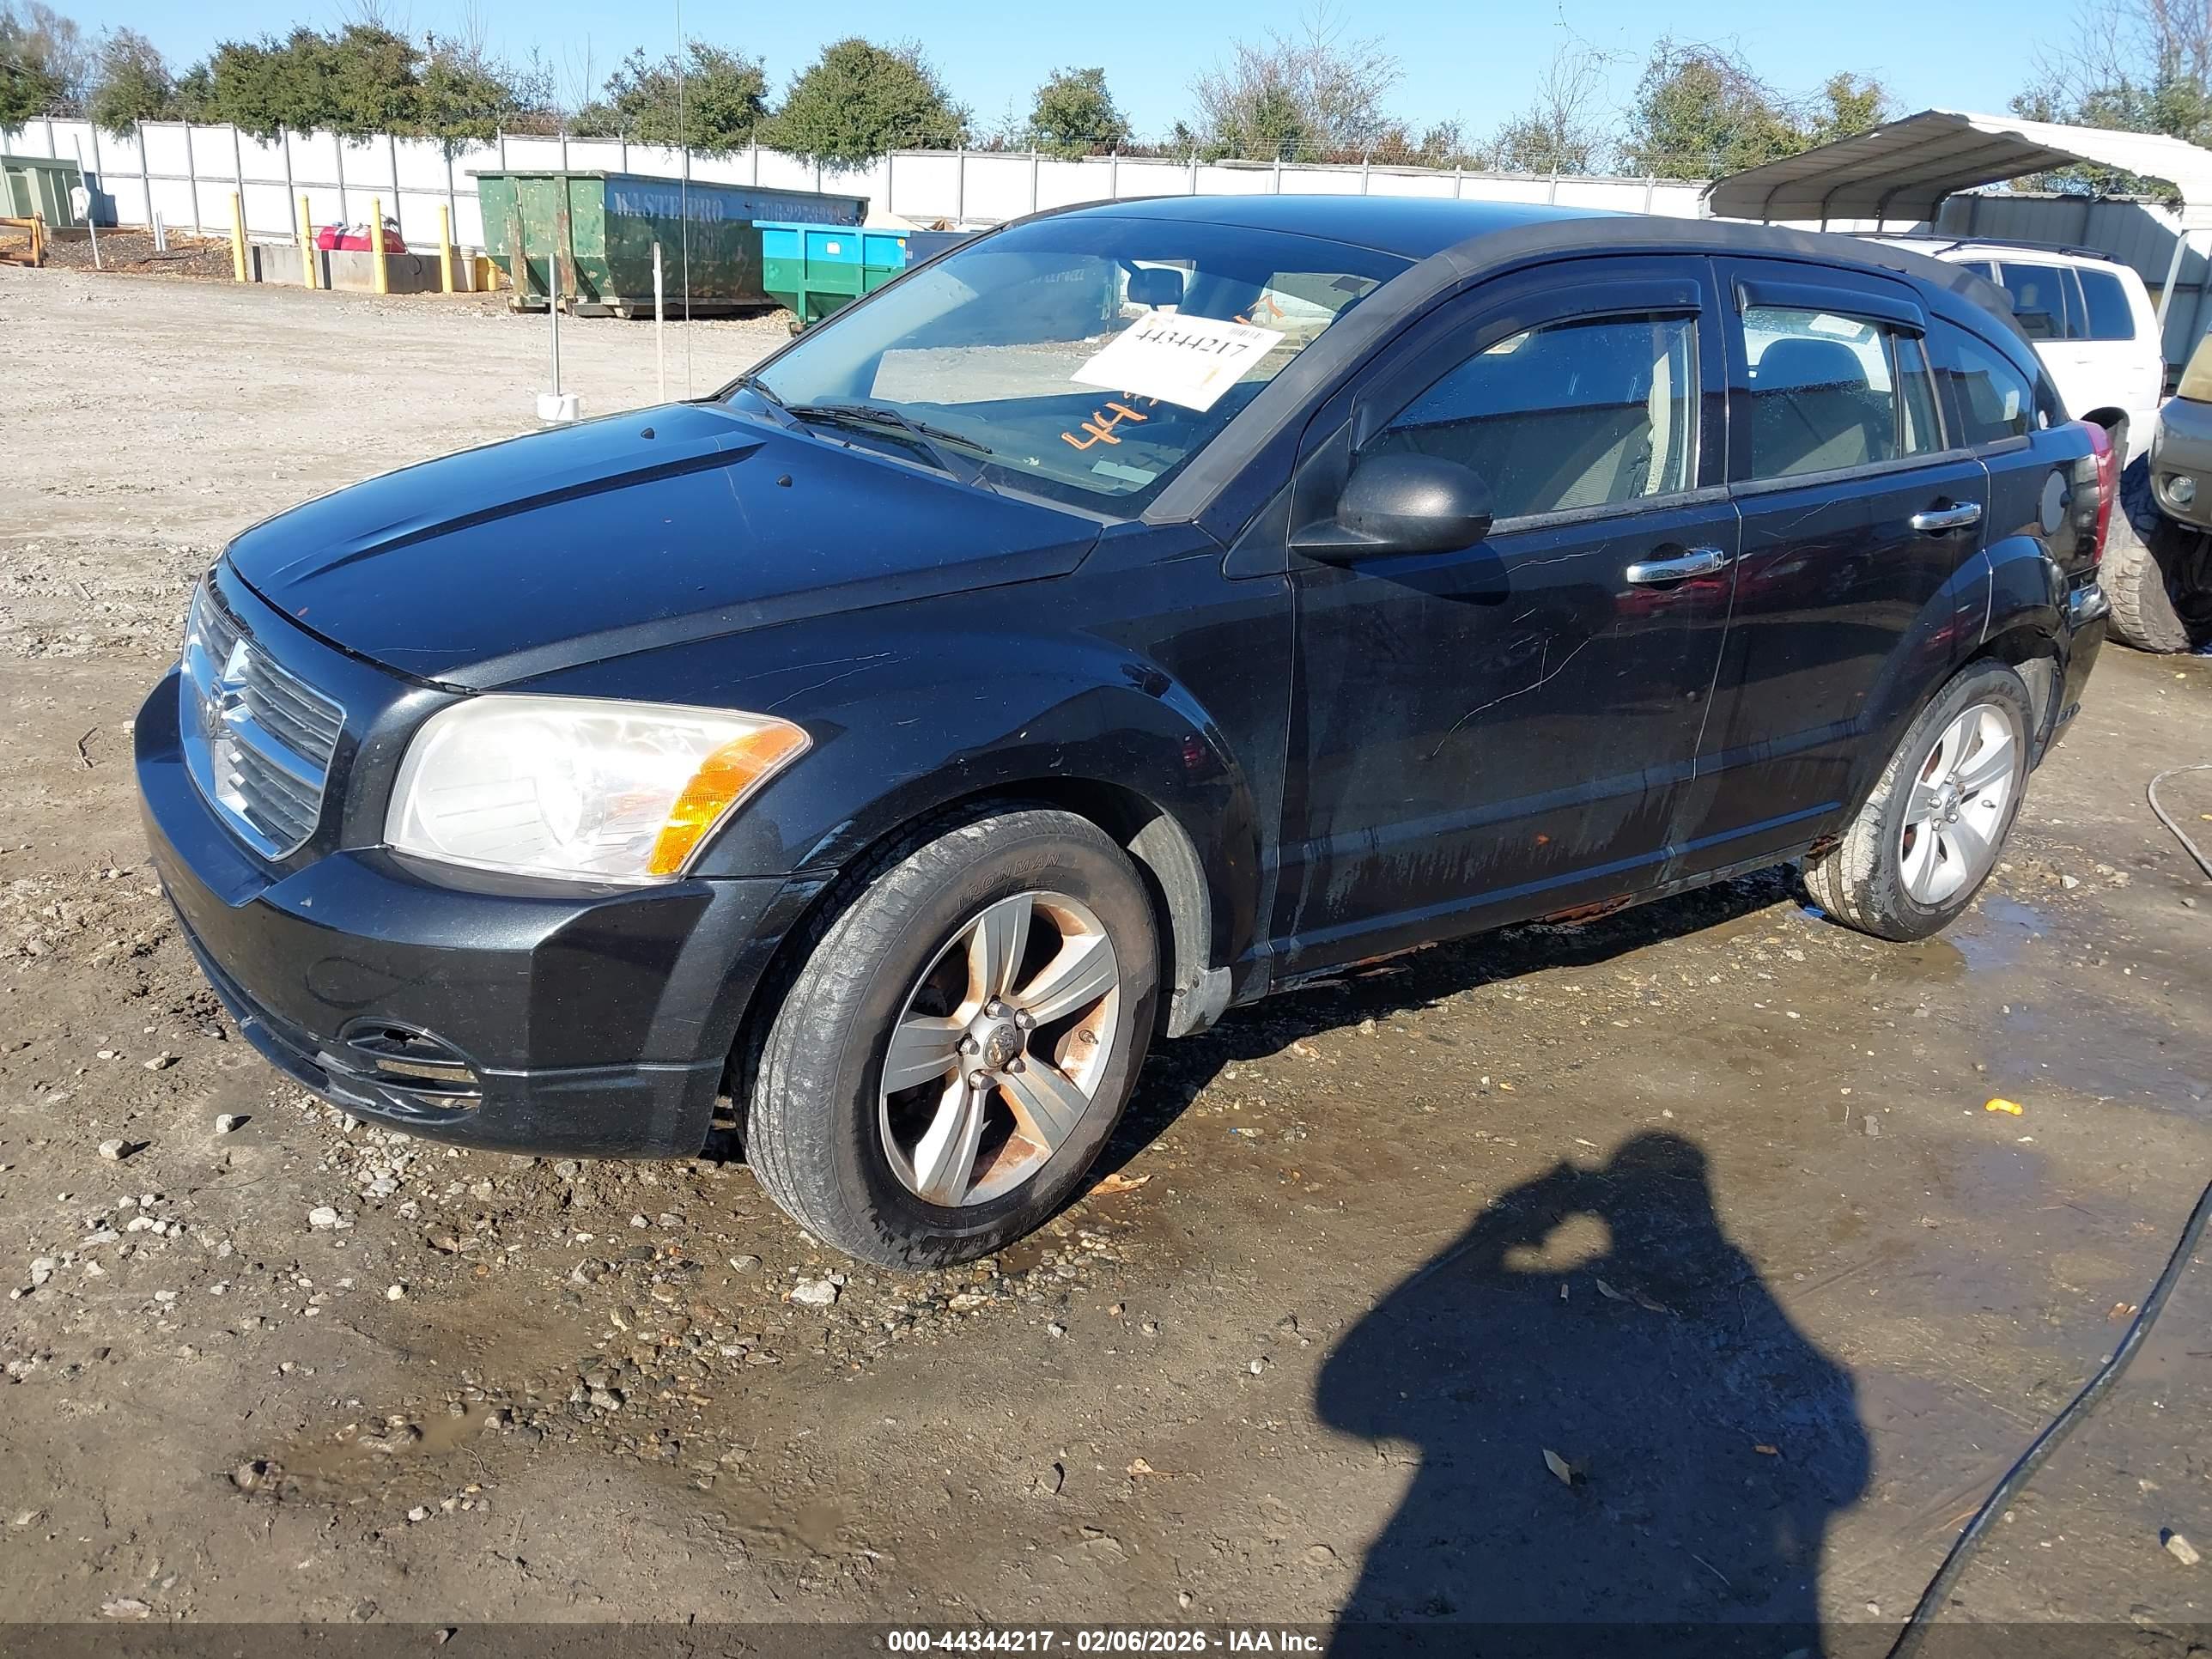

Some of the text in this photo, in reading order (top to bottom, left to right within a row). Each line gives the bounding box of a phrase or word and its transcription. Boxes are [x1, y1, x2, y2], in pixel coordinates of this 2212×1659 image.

[613, 191, 725, 224] WASTE PRO
[1135, 328, 1249, 357] 44344217
[957, 853, 1060, 910] IRONMAN
